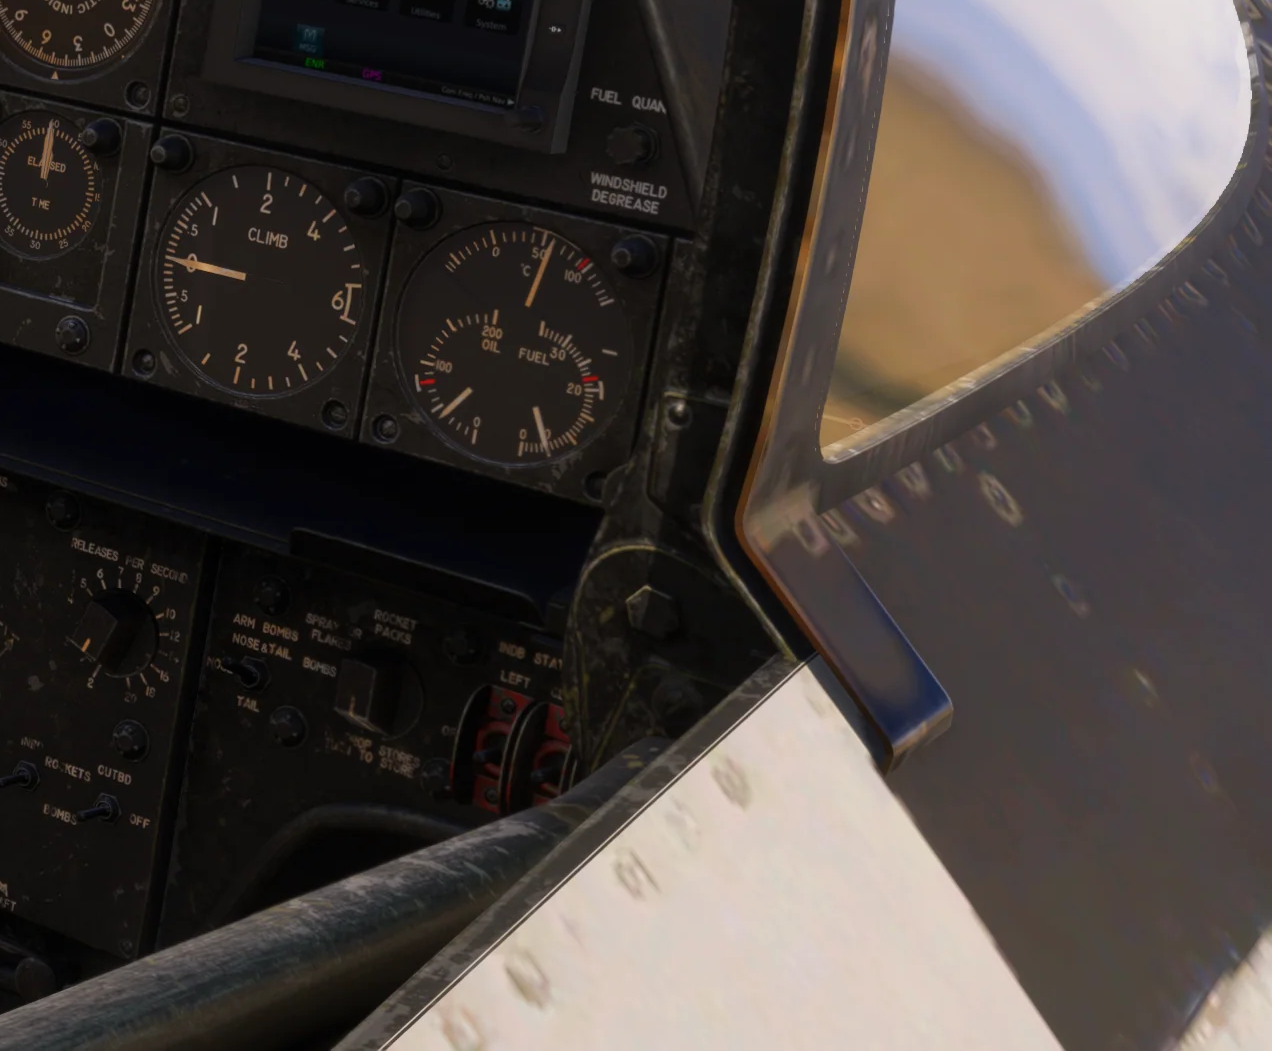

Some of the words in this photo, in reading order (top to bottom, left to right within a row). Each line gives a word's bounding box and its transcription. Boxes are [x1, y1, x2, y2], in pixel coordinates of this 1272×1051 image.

[475, 18, 507, 32] System
[305, 58, 325, 70] ENR
[362, 68, 383, 82] GPS
[590, 87, 622, 105] FUEL
[591, 171, 668, 199] WINDSHIELD
[591, 189, 660, 215] DEGREASE
[247, 227, 289, 249] CLIMB
[564, 269, 582, 284] 100
[481, 325, 503, 340] 200
[481, 338, 501, 354] OIL
[518, 348, 550, 366] FUEL
[435, 359, 453, 374] 100
[566, 382, 582, 396] 20
[71, 537, 119, 562] RELEASES
[233, 613, 256, 630] ARM
[262, 621, 299, 642] BOMBS
[302, 656, 337, 678] BOMBS
[500, 669, 532, 689] LEFT
[236, 695, 260, 713] TAIL
